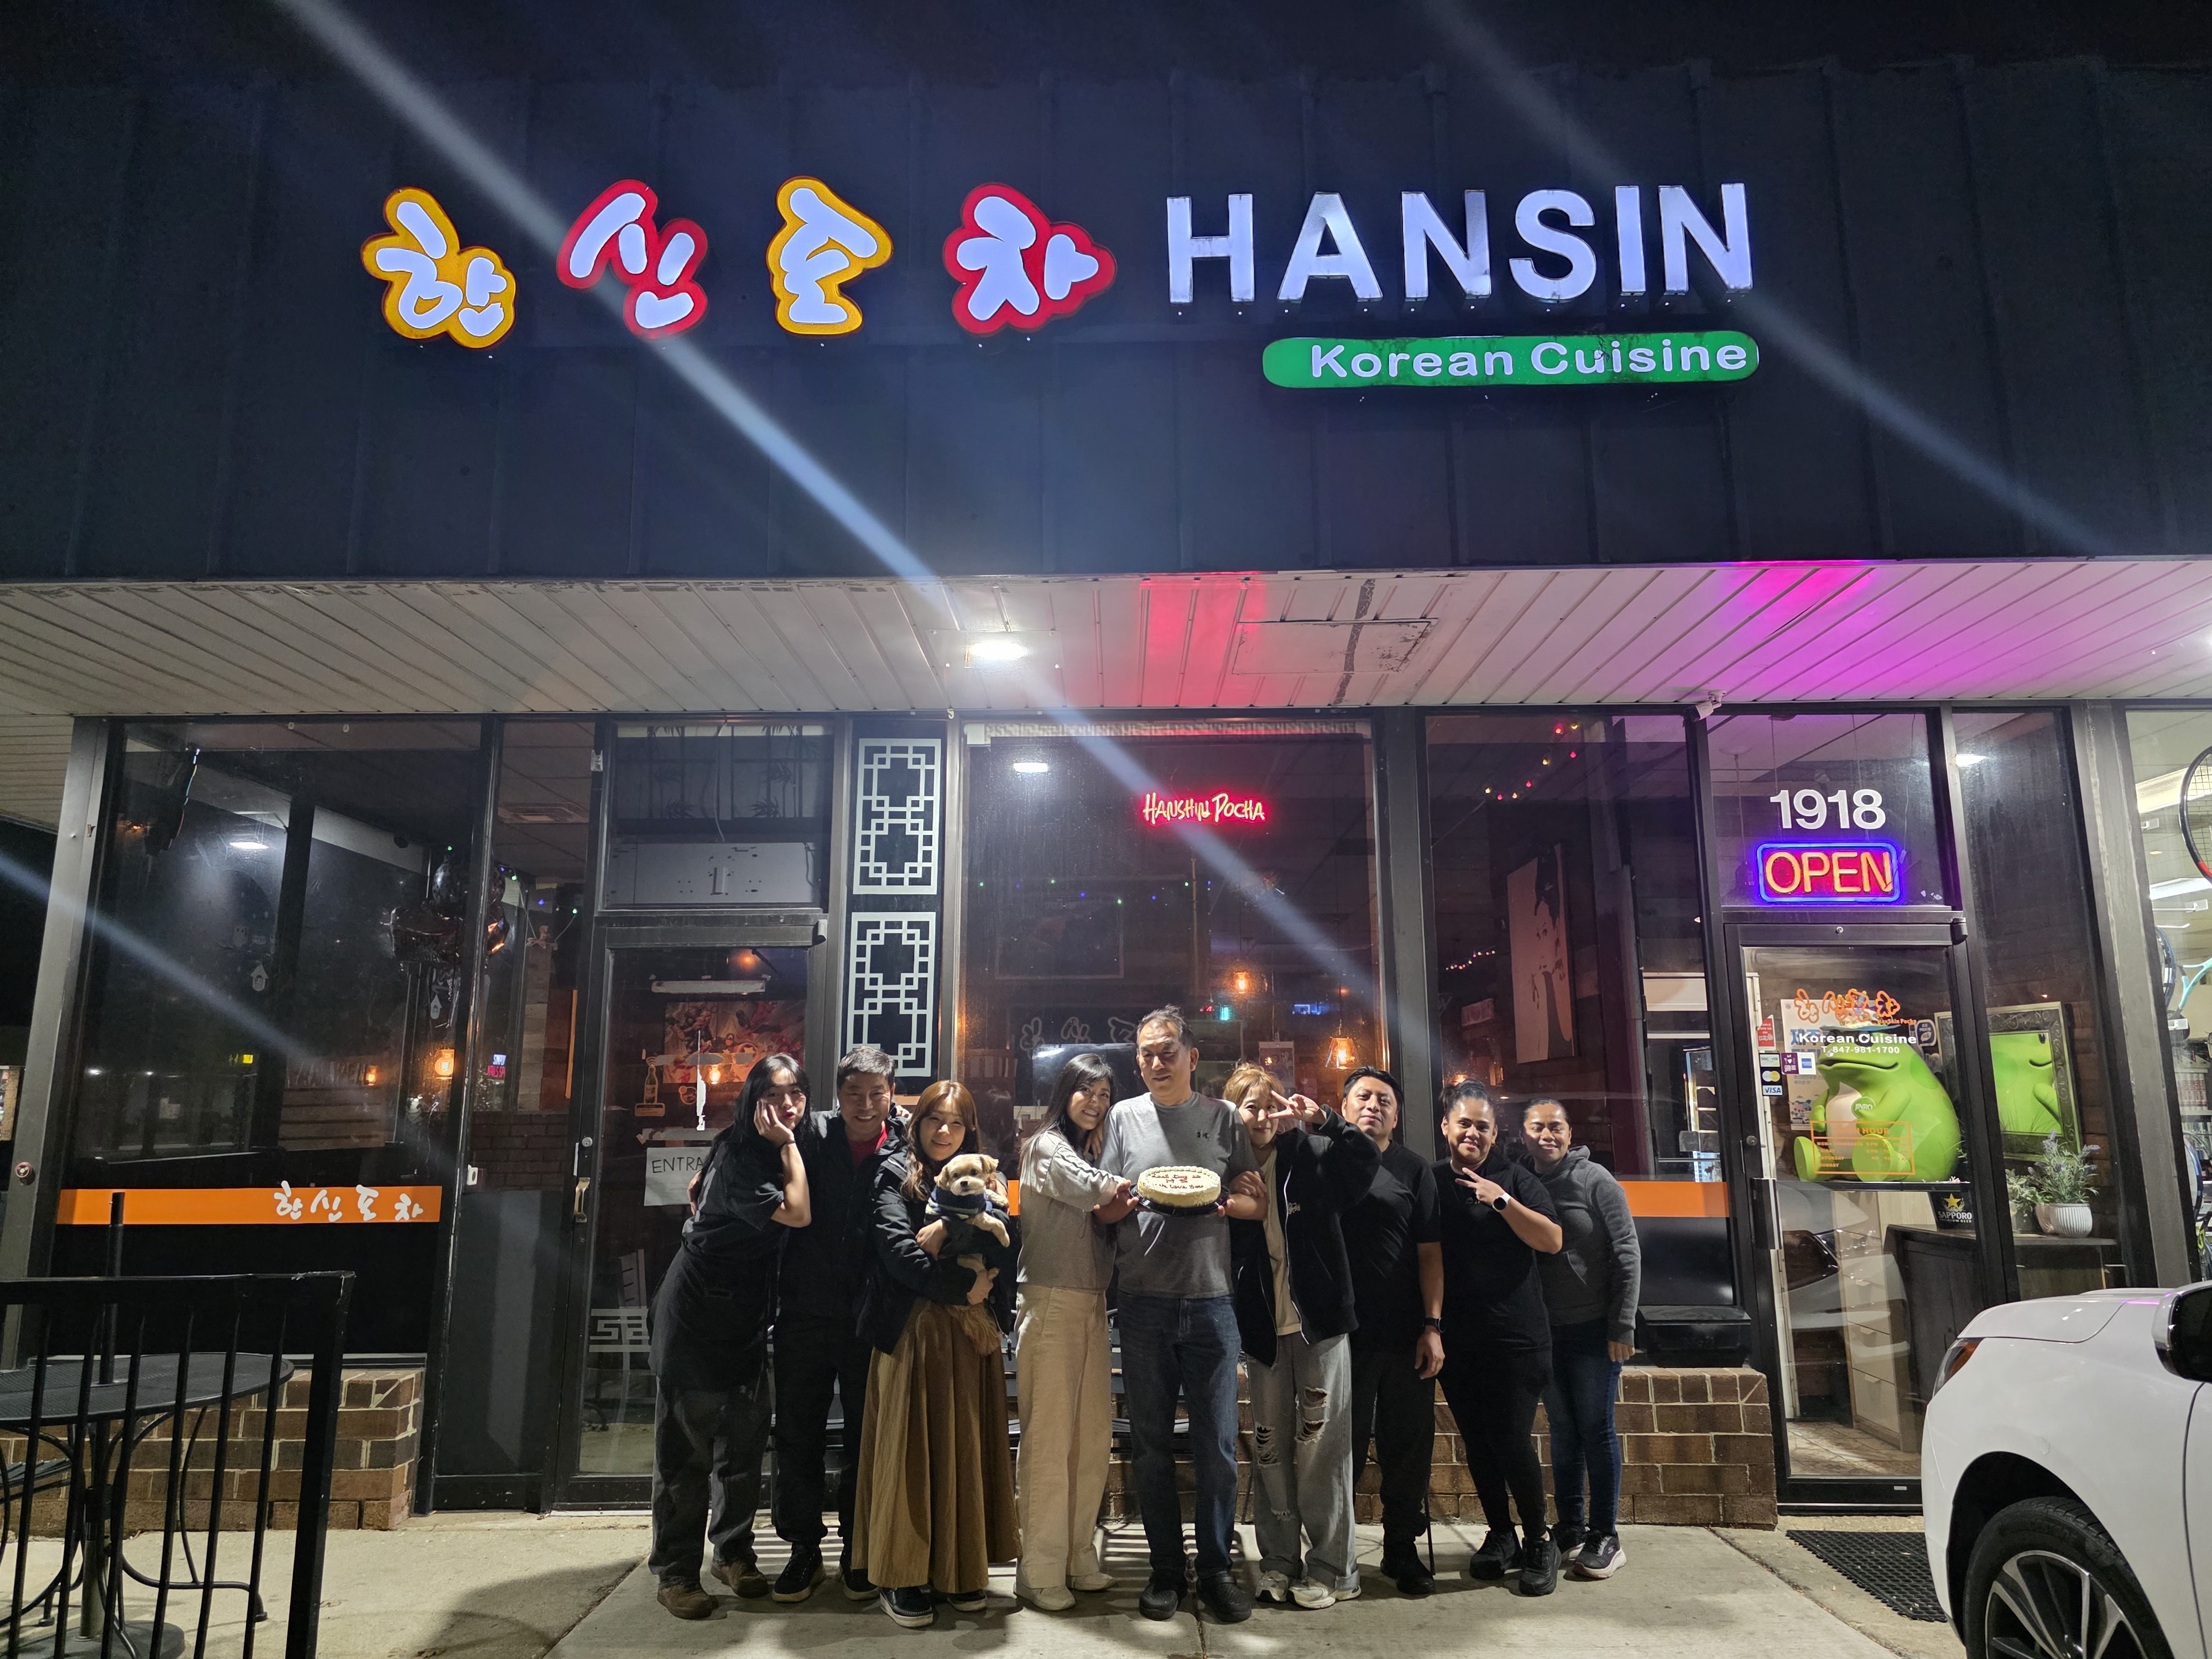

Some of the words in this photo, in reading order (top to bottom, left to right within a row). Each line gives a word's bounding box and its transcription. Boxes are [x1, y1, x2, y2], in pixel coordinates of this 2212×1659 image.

[1166, 183, 1754, 304] HANSIN
[1310, 343, 1514, 380] Korean
[1530, 338, 1749, 375] Cuisine
[1770, 789, 1886, 830] 1918
[1765, 851, 1893, 894] OPEN
[1799, 1033, 1855, 1044] Korean
[1858, 1032, 1917, 1044] Cuisine
[652, 1156, 703, 1173] ENTRA
[1938, 1211, 1973, 1219] SAPPORO
